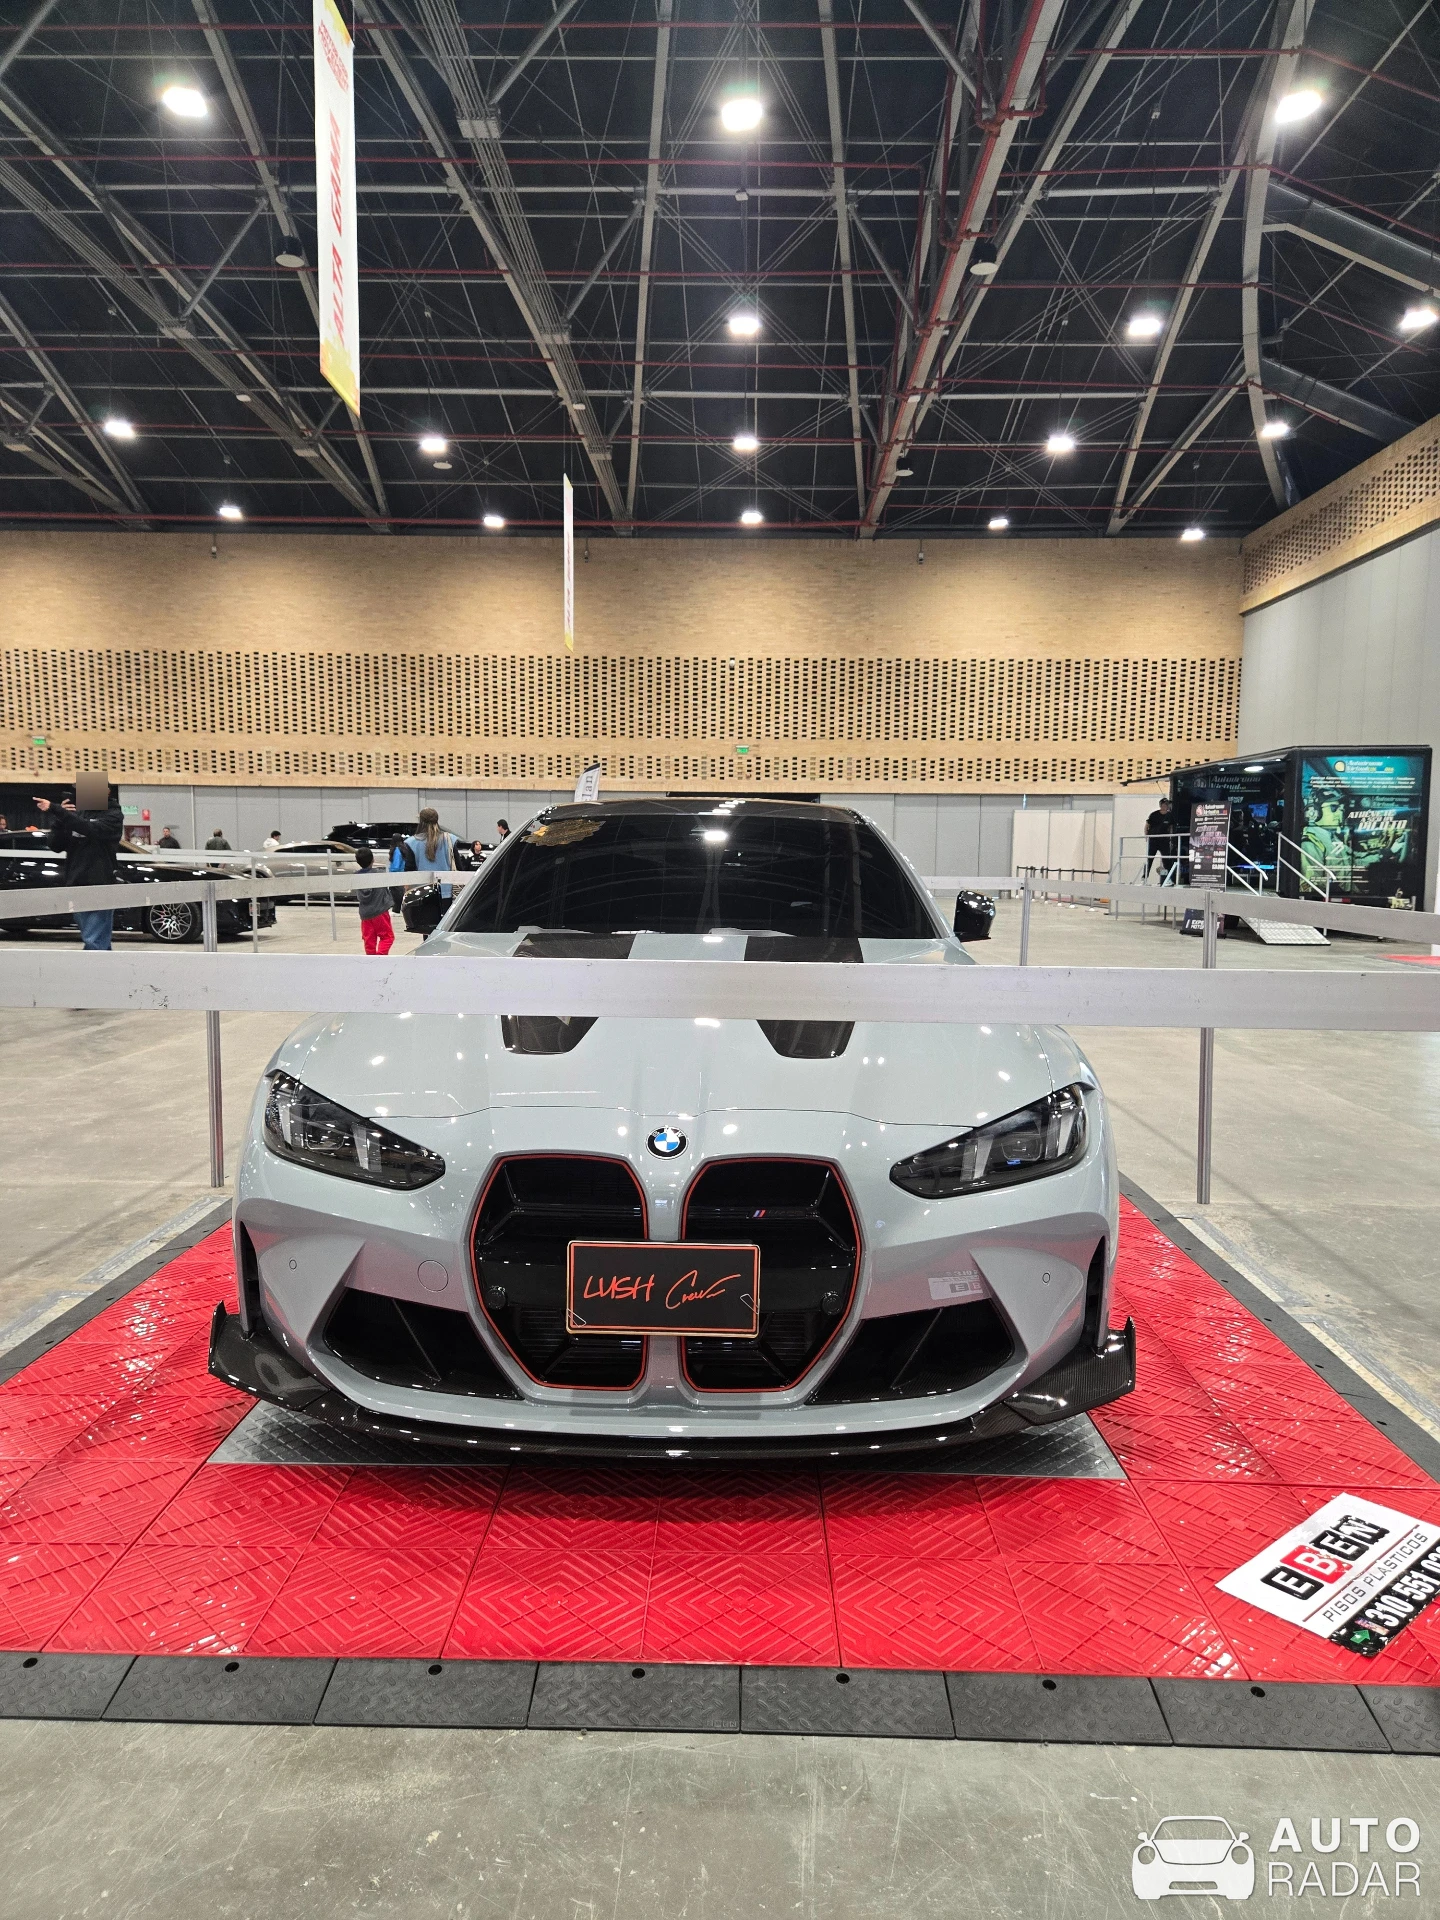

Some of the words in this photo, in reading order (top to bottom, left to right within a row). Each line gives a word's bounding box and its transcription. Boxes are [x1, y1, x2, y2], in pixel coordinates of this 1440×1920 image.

[329, 108, 342, 238] GAMA
[331, 242, 344, 347] ALTA
[581, 775, 593, 802] lan
[583, 1274, 655, 1302] LUSH
[1262, 1515, 1389, 1600] EBEN
[1322, 1586, 1367, 1622] PISOS
[1363, 1533, 1428, 1588] PLASTICOS
[1365, 1594, 1414, 1628] 310
[1391, 1570, 1440, 1601] 551
